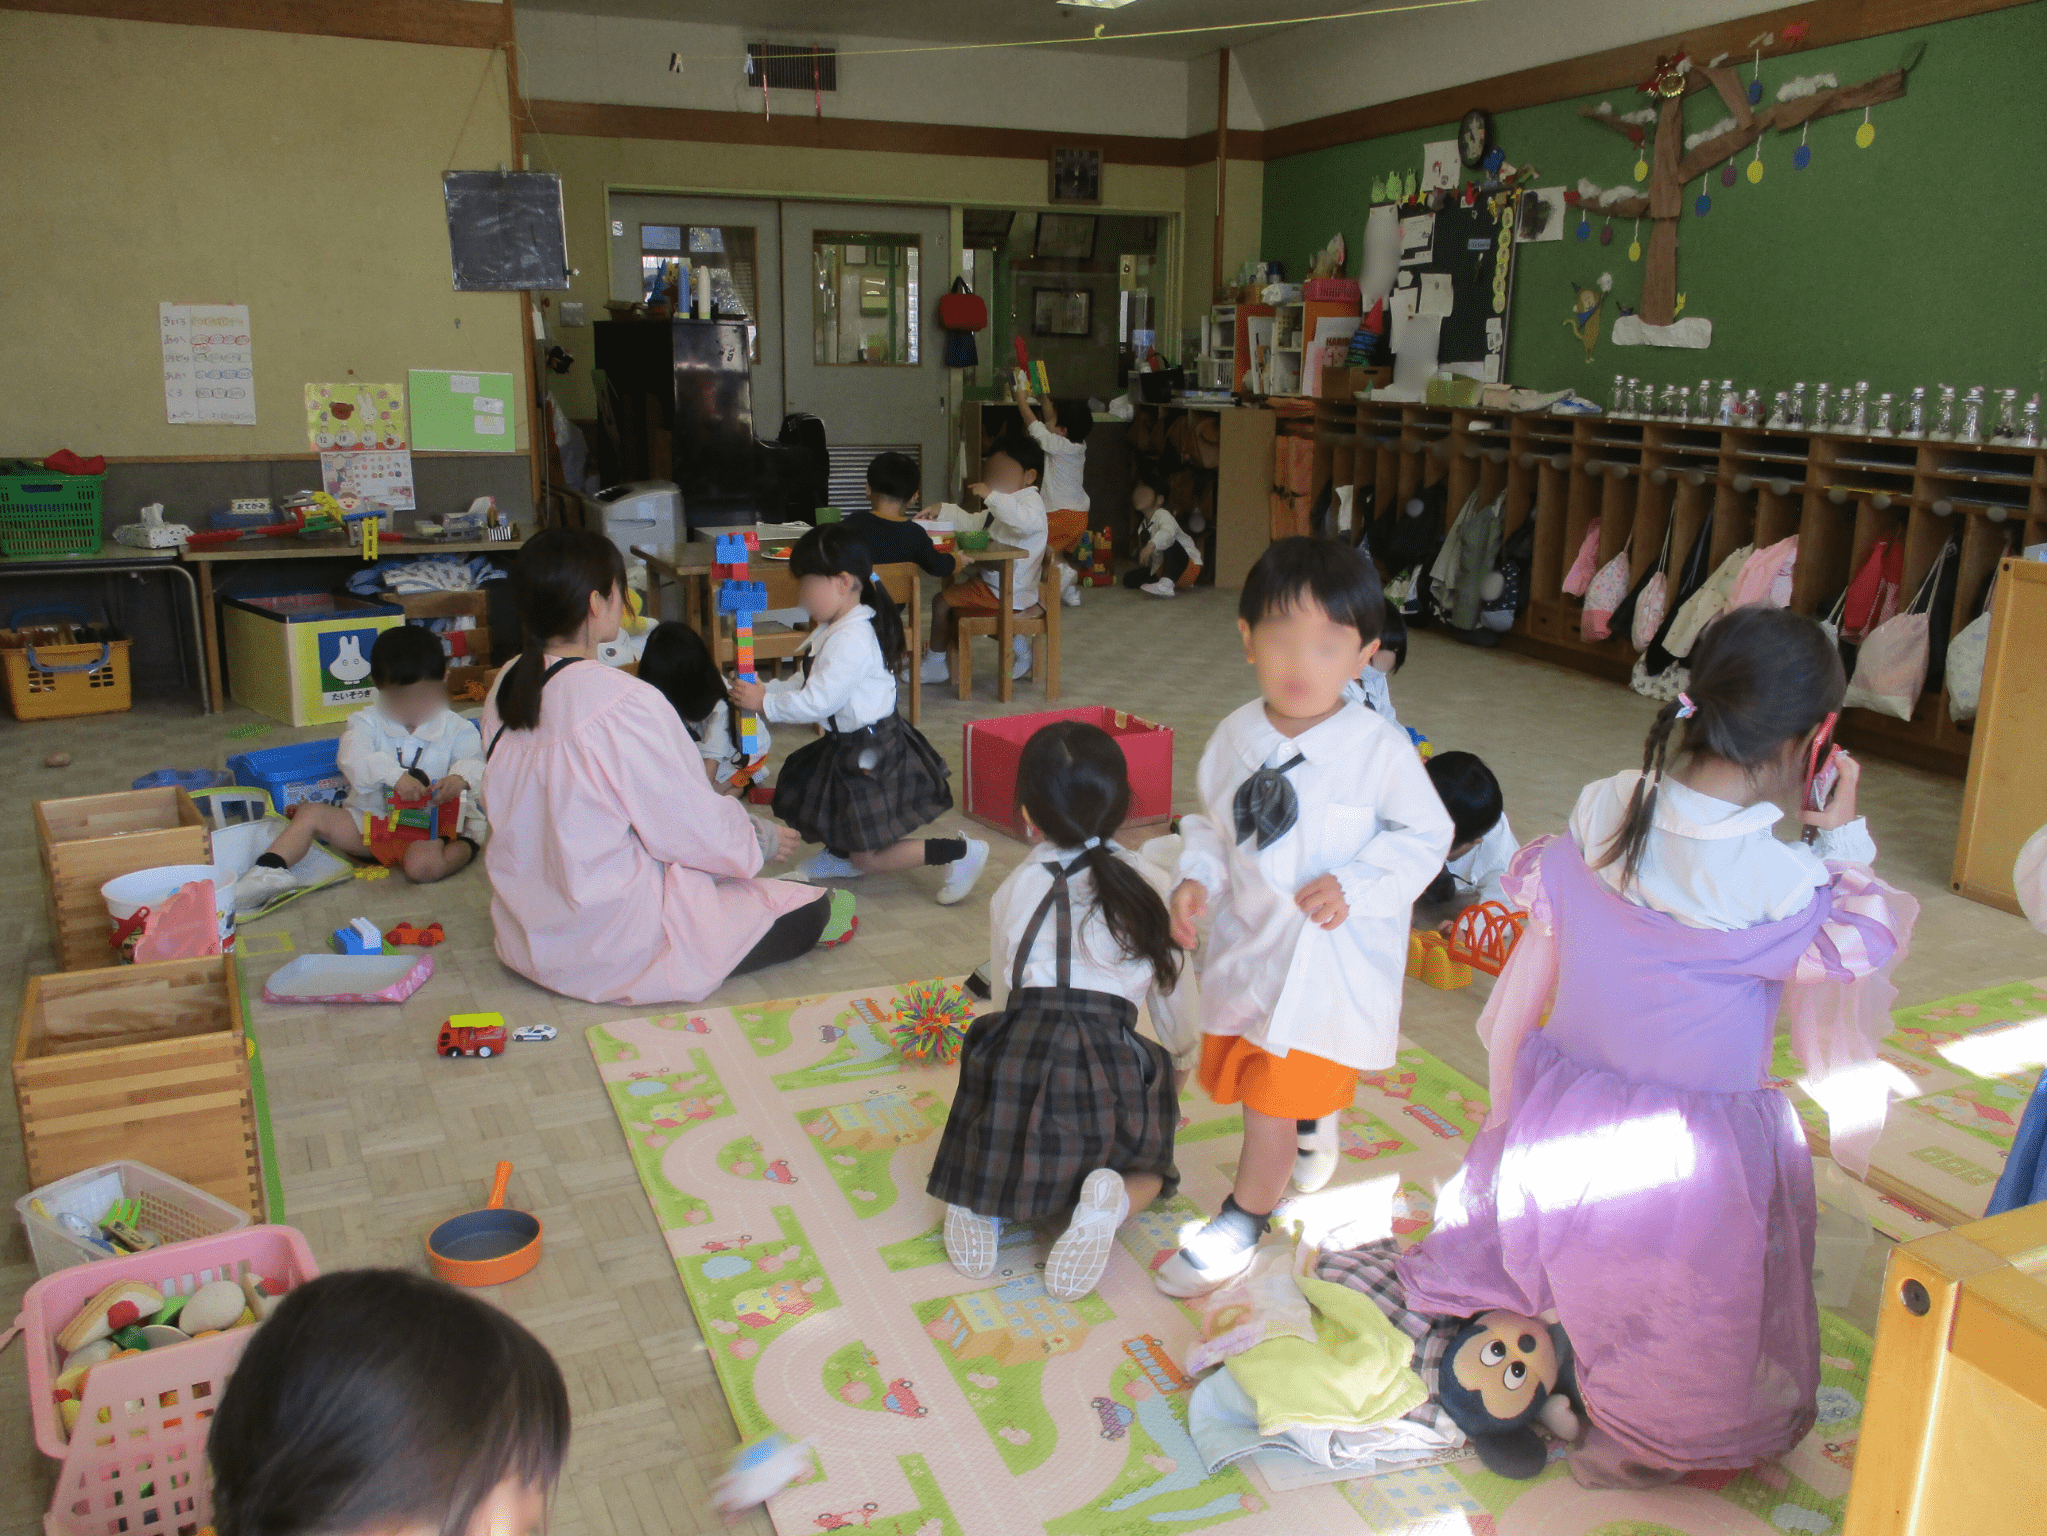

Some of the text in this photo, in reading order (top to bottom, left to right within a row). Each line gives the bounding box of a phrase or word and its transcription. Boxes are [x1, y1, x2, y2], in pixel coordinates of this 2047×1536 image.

[1326, 337, 1350, 346] HARIB
[237, 502, 265, 510] おてがみ
